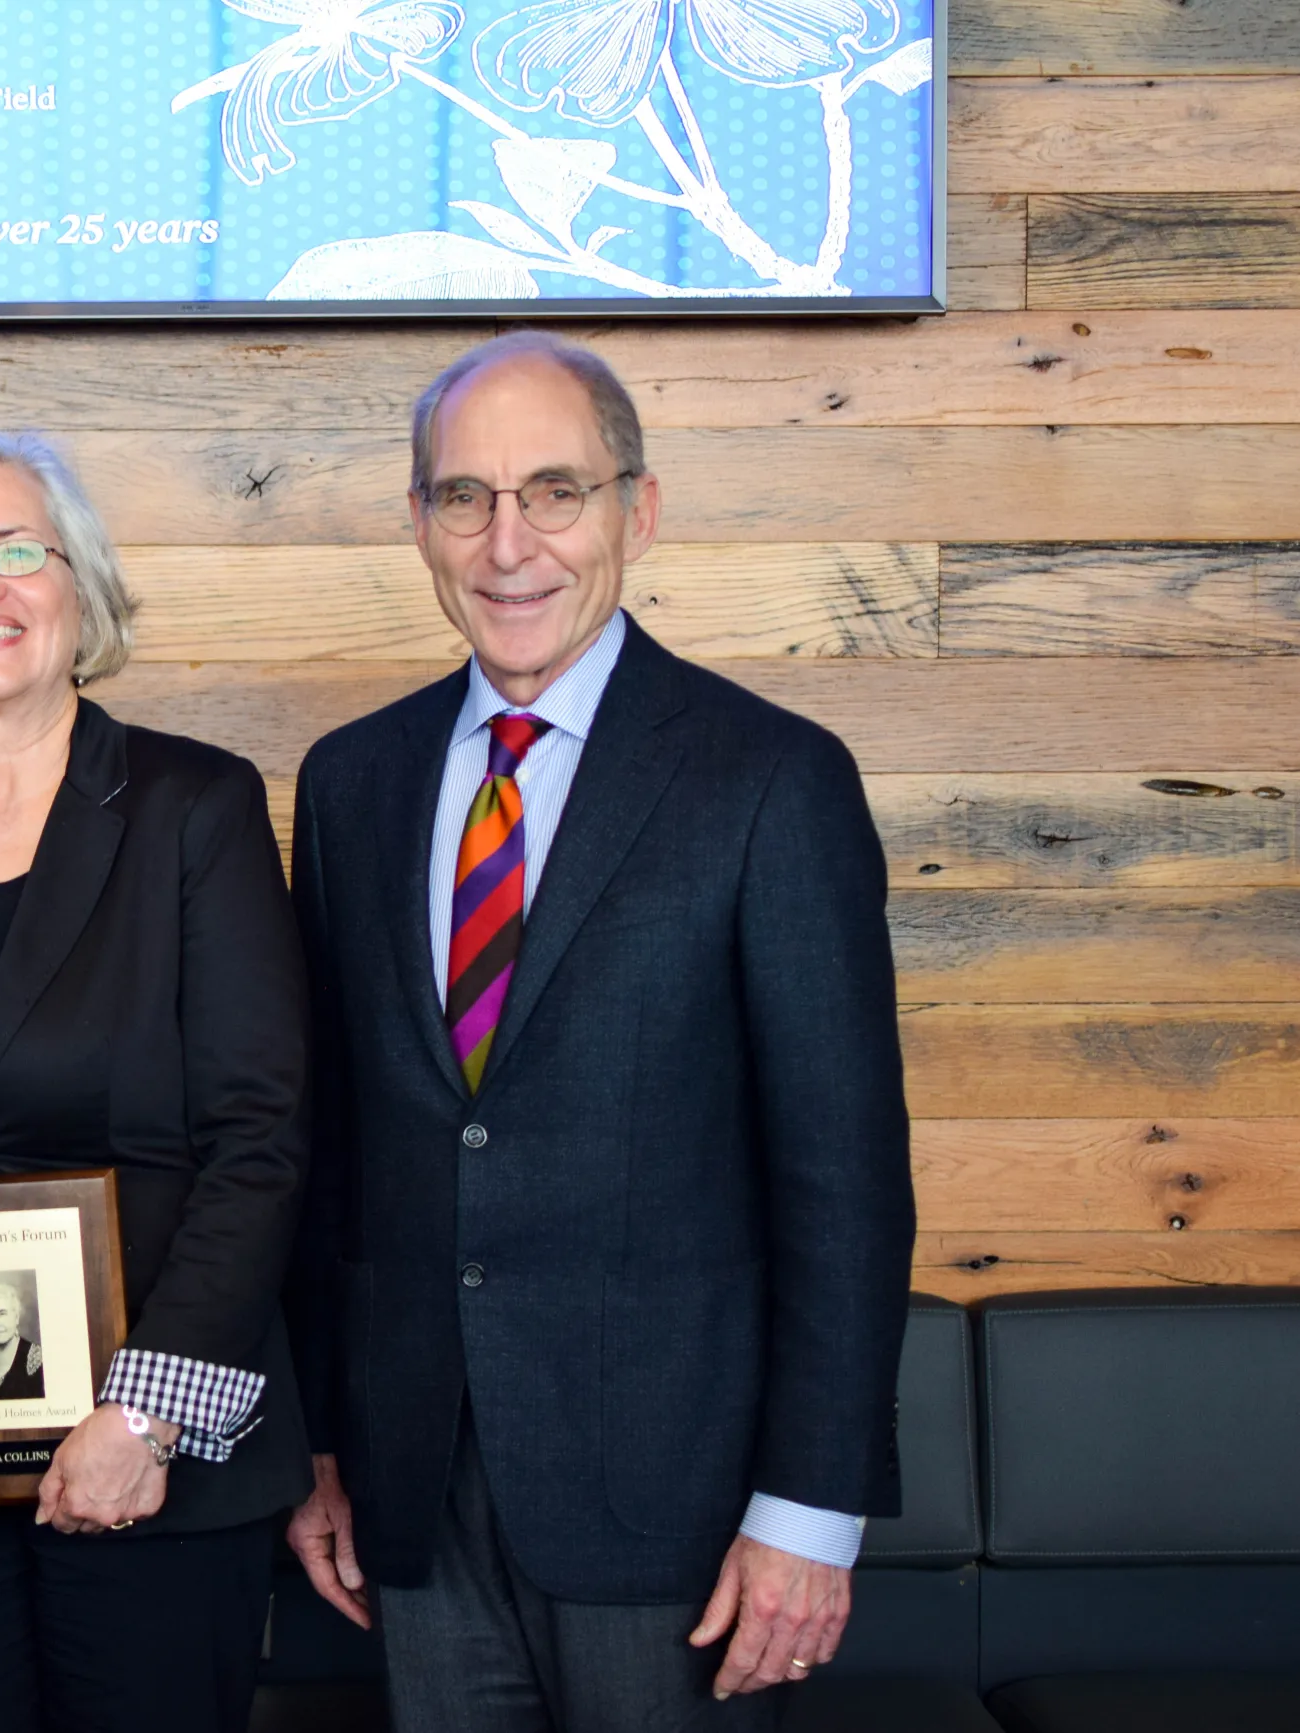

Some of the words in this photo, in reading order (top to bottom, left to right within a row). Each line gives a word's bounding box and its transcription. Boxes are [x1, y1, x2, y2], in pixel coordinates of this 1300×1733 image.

[57, 213, 106, 244] 25
[112, 216, 220, 253] years
[22, 1229, 67, 1242] Forum
[4, 1408, 42, 1419] Holmes
[45, 1406, 77, 1417] Award
[4, 1450, 50, 1462] COLLINS
